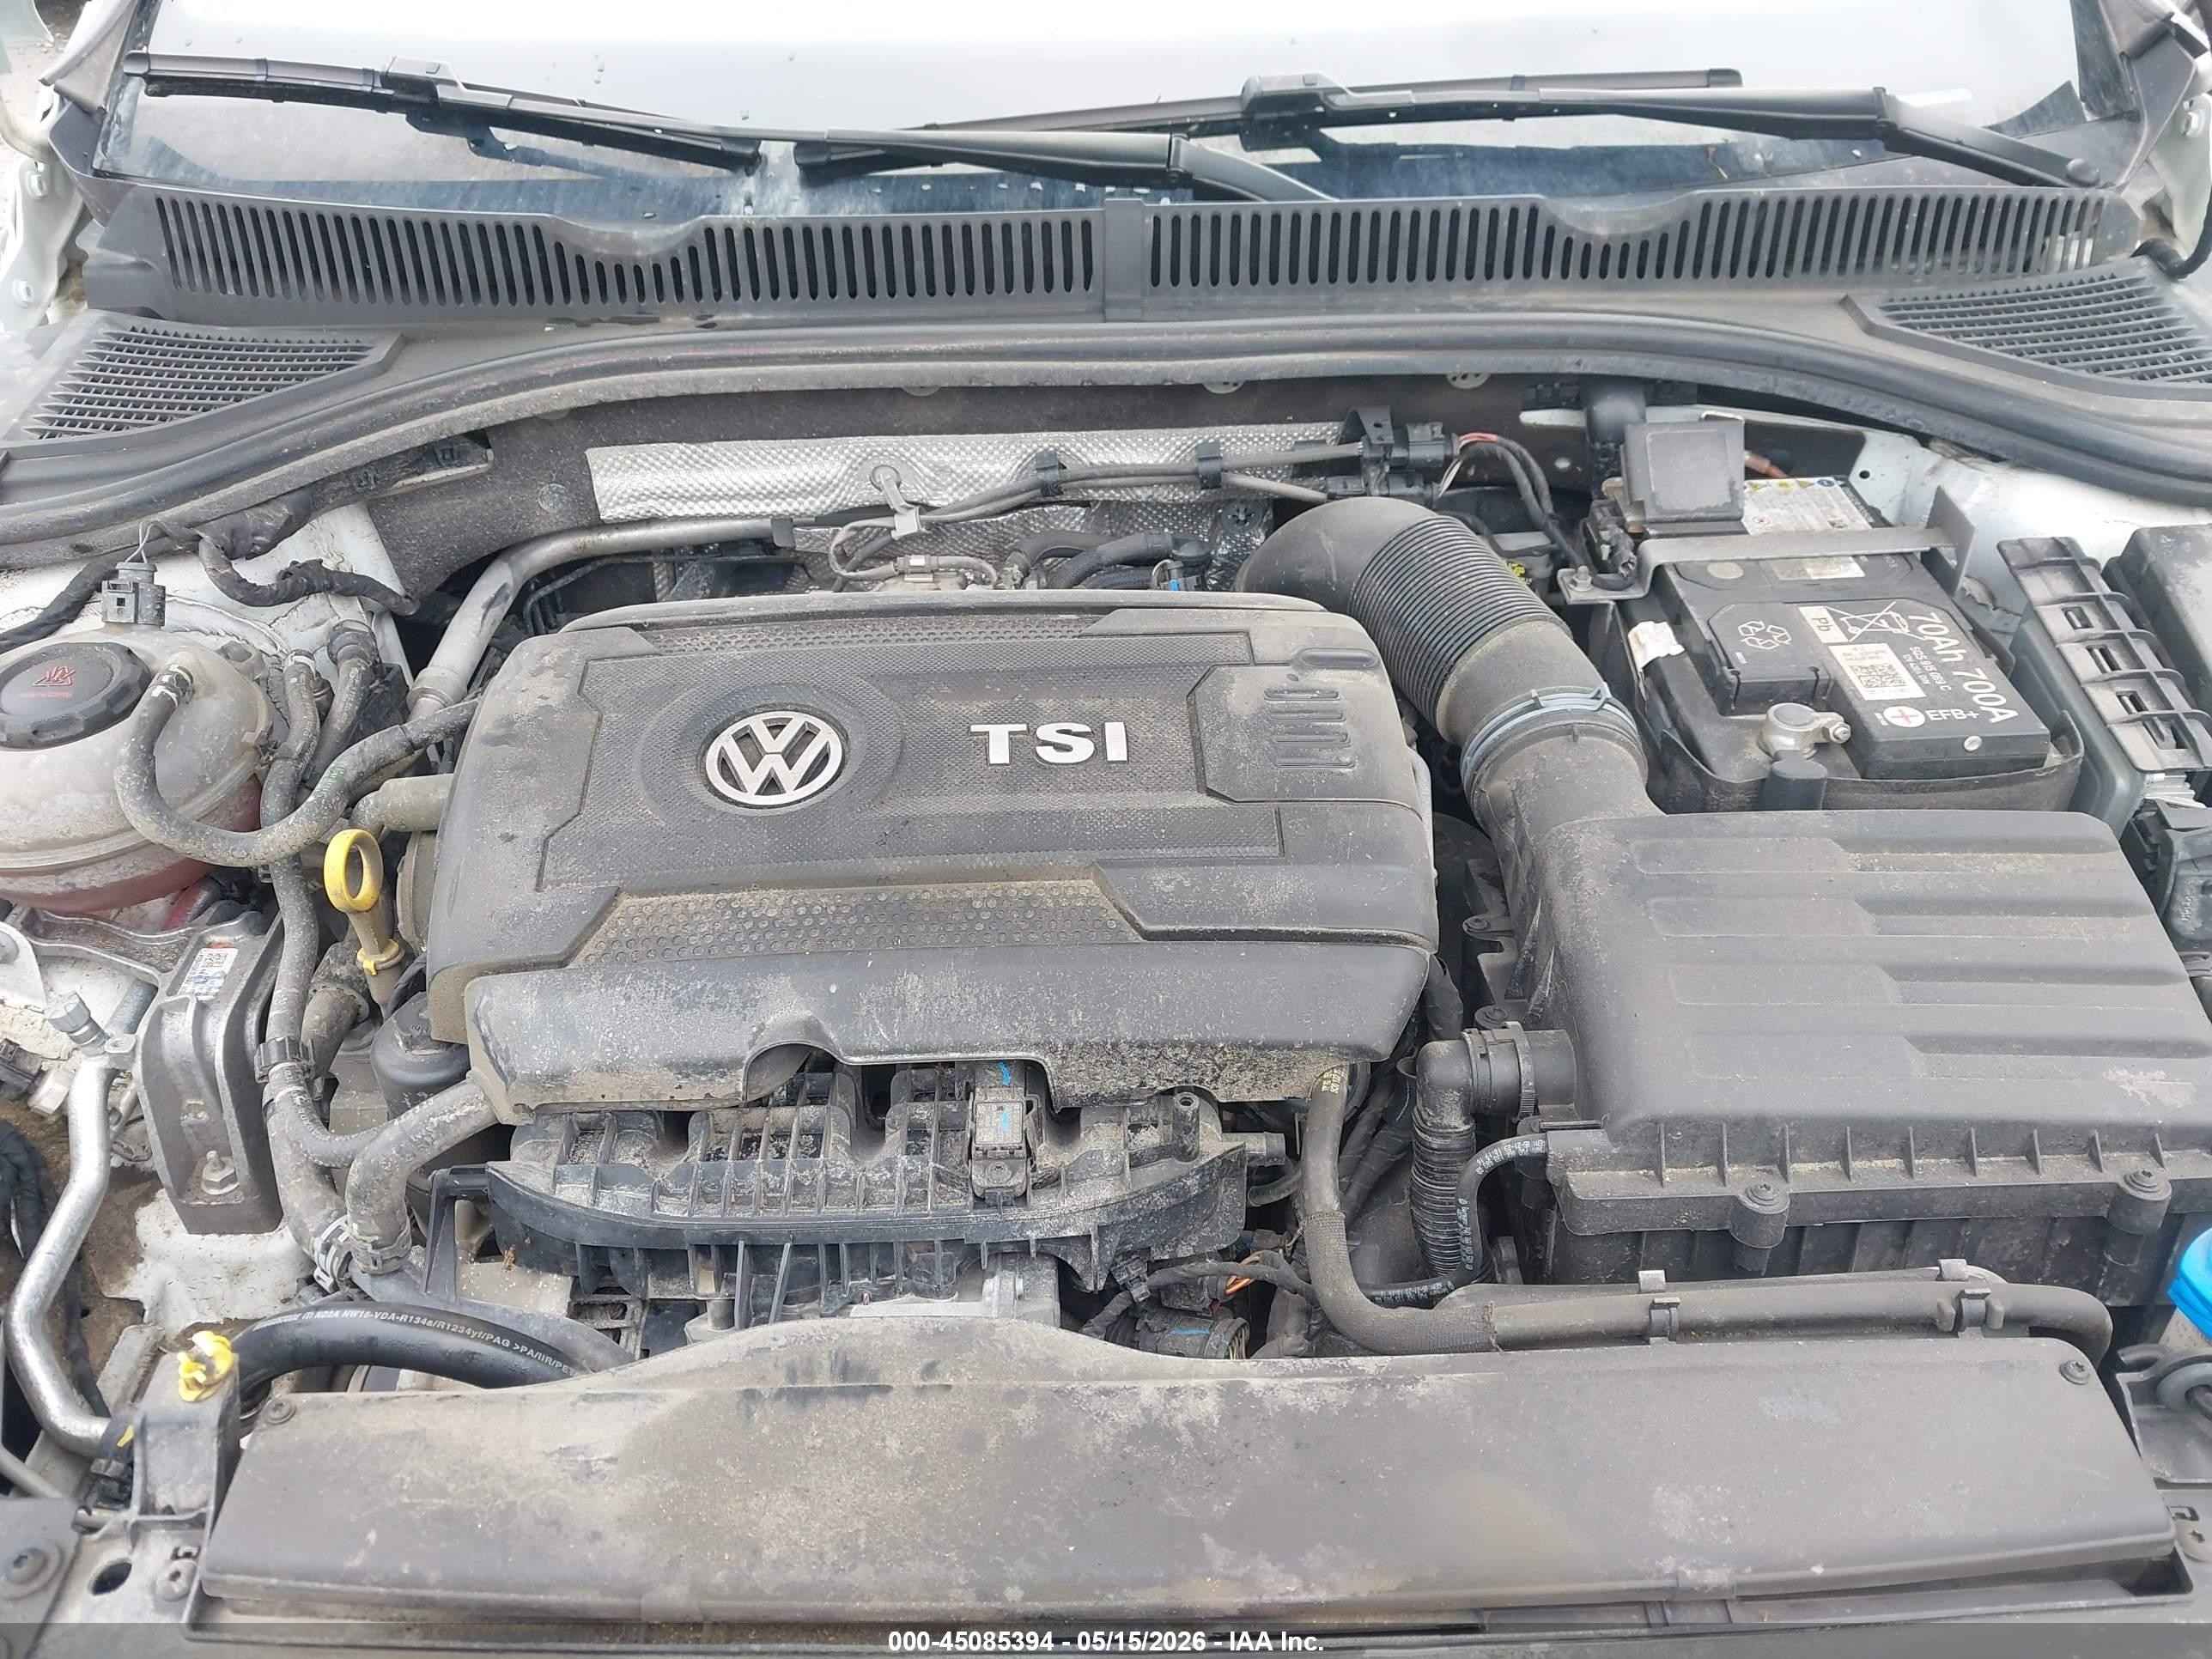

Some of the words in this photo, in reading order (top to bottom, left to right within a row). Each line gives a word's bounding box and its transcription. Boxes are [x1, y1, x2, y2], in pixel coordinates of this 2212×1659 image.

[1811, 617, 1832, 633] Pb
[1908, 611, 1967, 662] 70Ah
[1952, 667, 2019, 724] 700A
[1925, 708, 1980, 721] EFB+
[970, 721, 1129, 765] TSI
